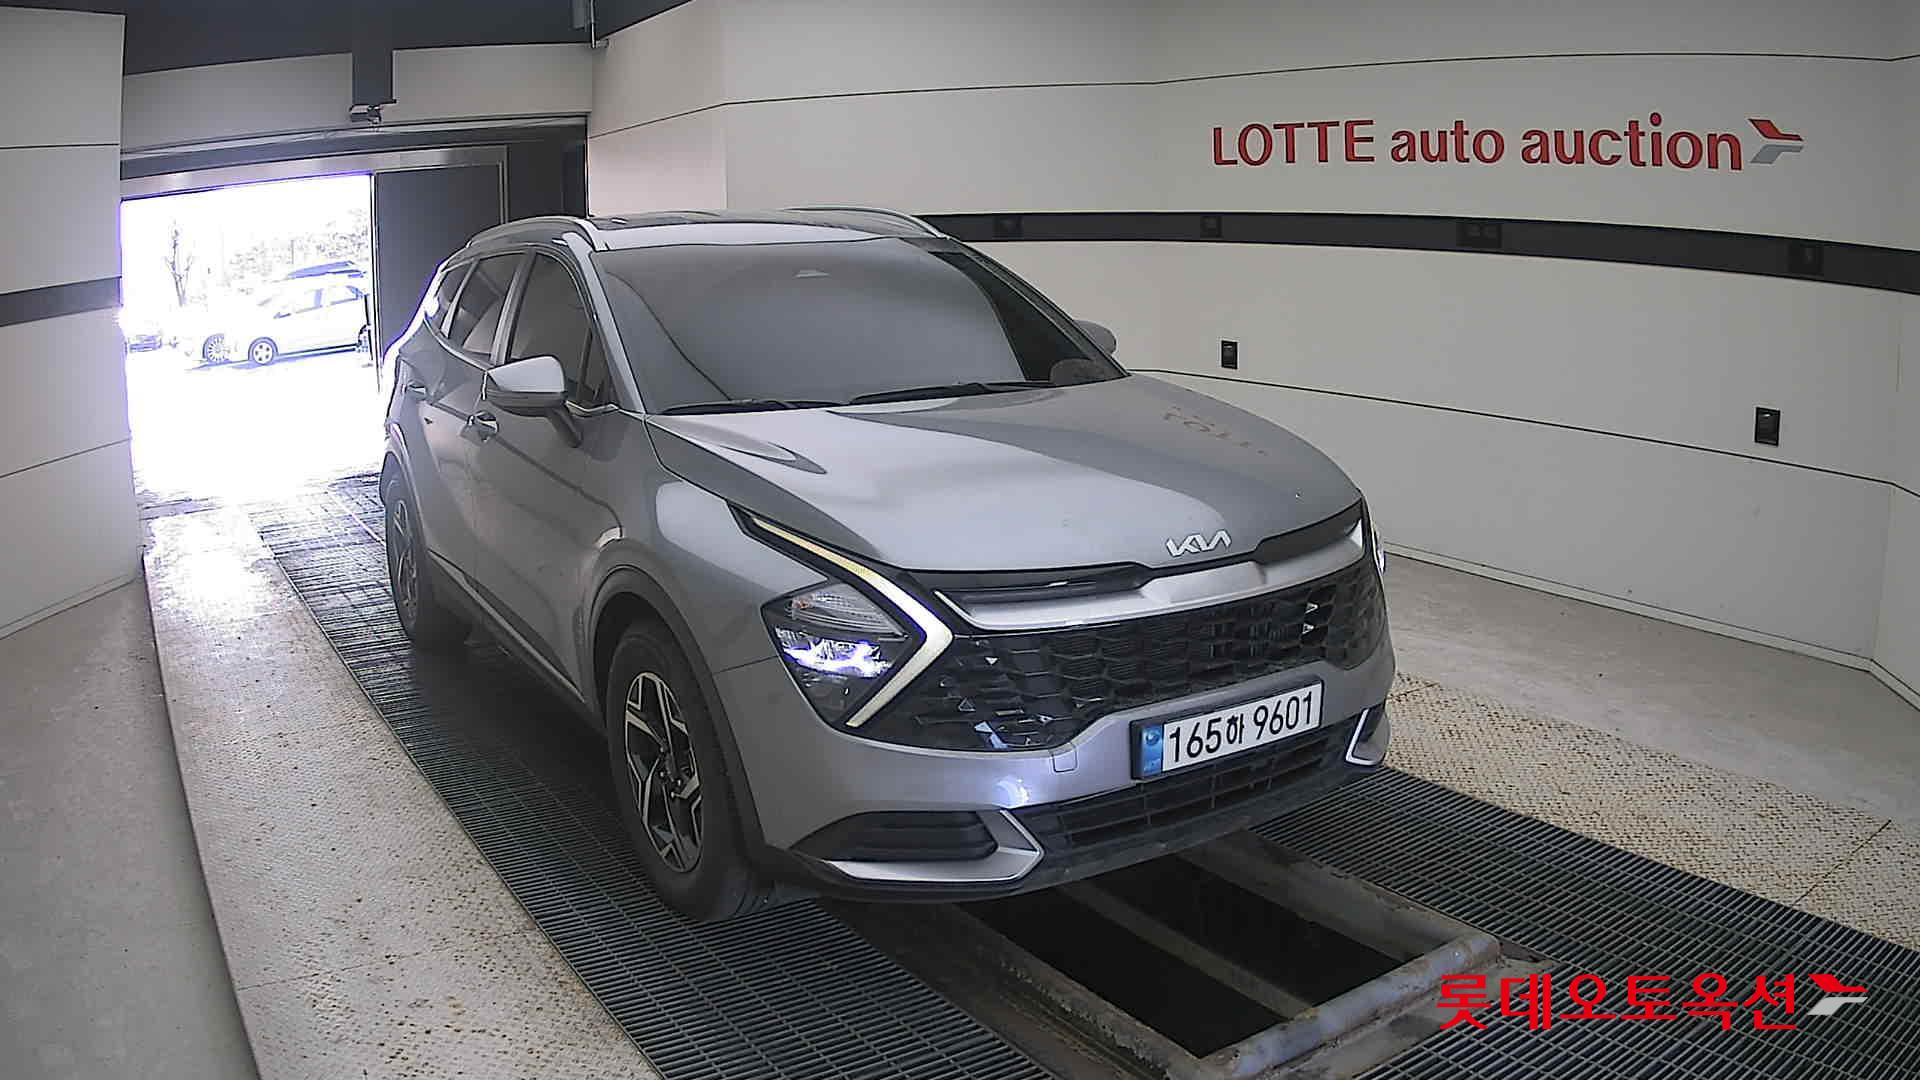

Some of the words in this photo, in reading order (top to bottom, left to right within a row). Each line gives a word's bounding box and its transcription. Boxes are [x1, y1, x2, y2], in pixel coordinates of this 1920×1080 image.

[1212, 119, 1375, 167] LOTTE
[1390, 119, 1505, 165] auto
[1521, 112, 1743, 171] auction
[1169, 713, 1245, 762] 165하
[1253, 691, 1313, 740] 9601
